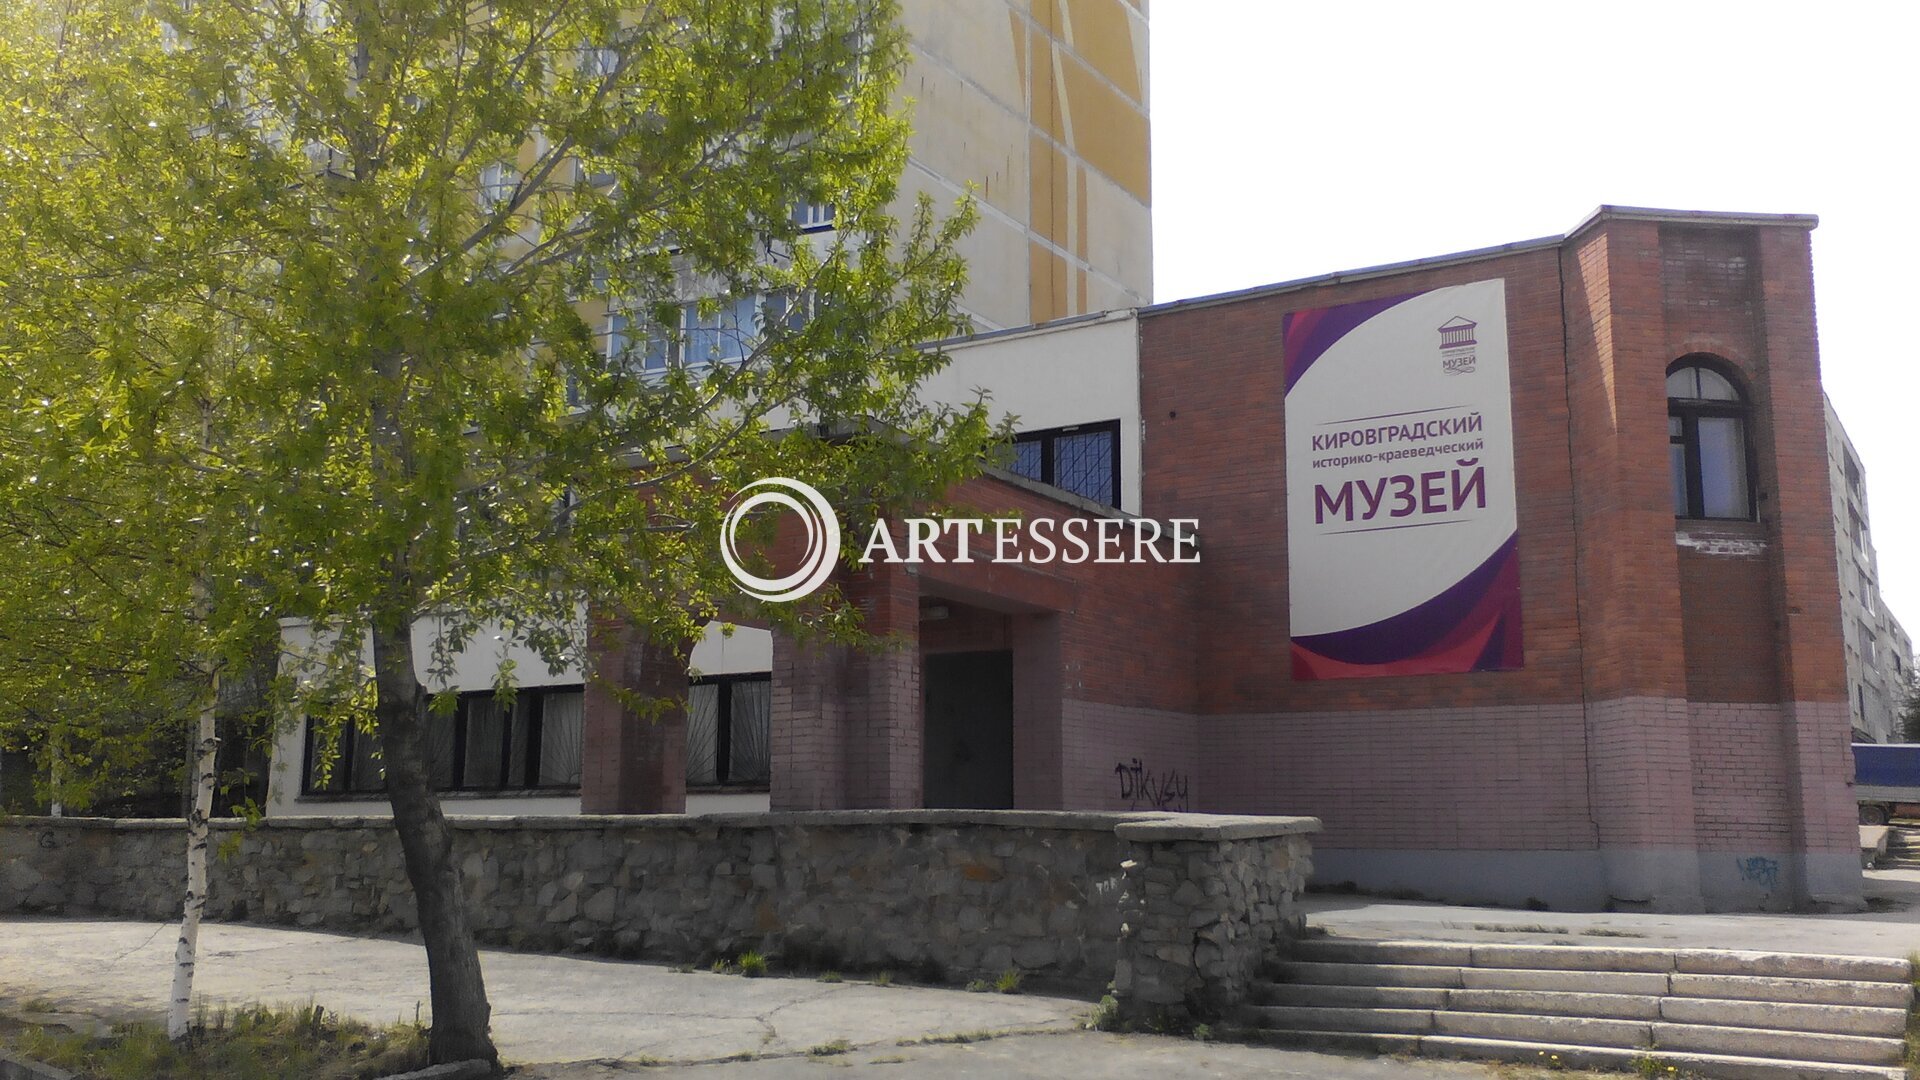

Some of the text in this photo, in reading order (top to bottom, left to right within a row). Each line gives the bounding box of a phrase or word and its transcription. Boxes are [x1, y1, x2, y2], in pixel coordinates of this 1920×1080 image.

[1442, 355, 1476, 369] МУЗЕЙ
[1312, 412, 1482, 451] КИРОВГРАДСКИЙ
[1312, 438, 1484, 469] историко-краеведческий
[1314, 457, 1486, 525] МУЗЕЙ
